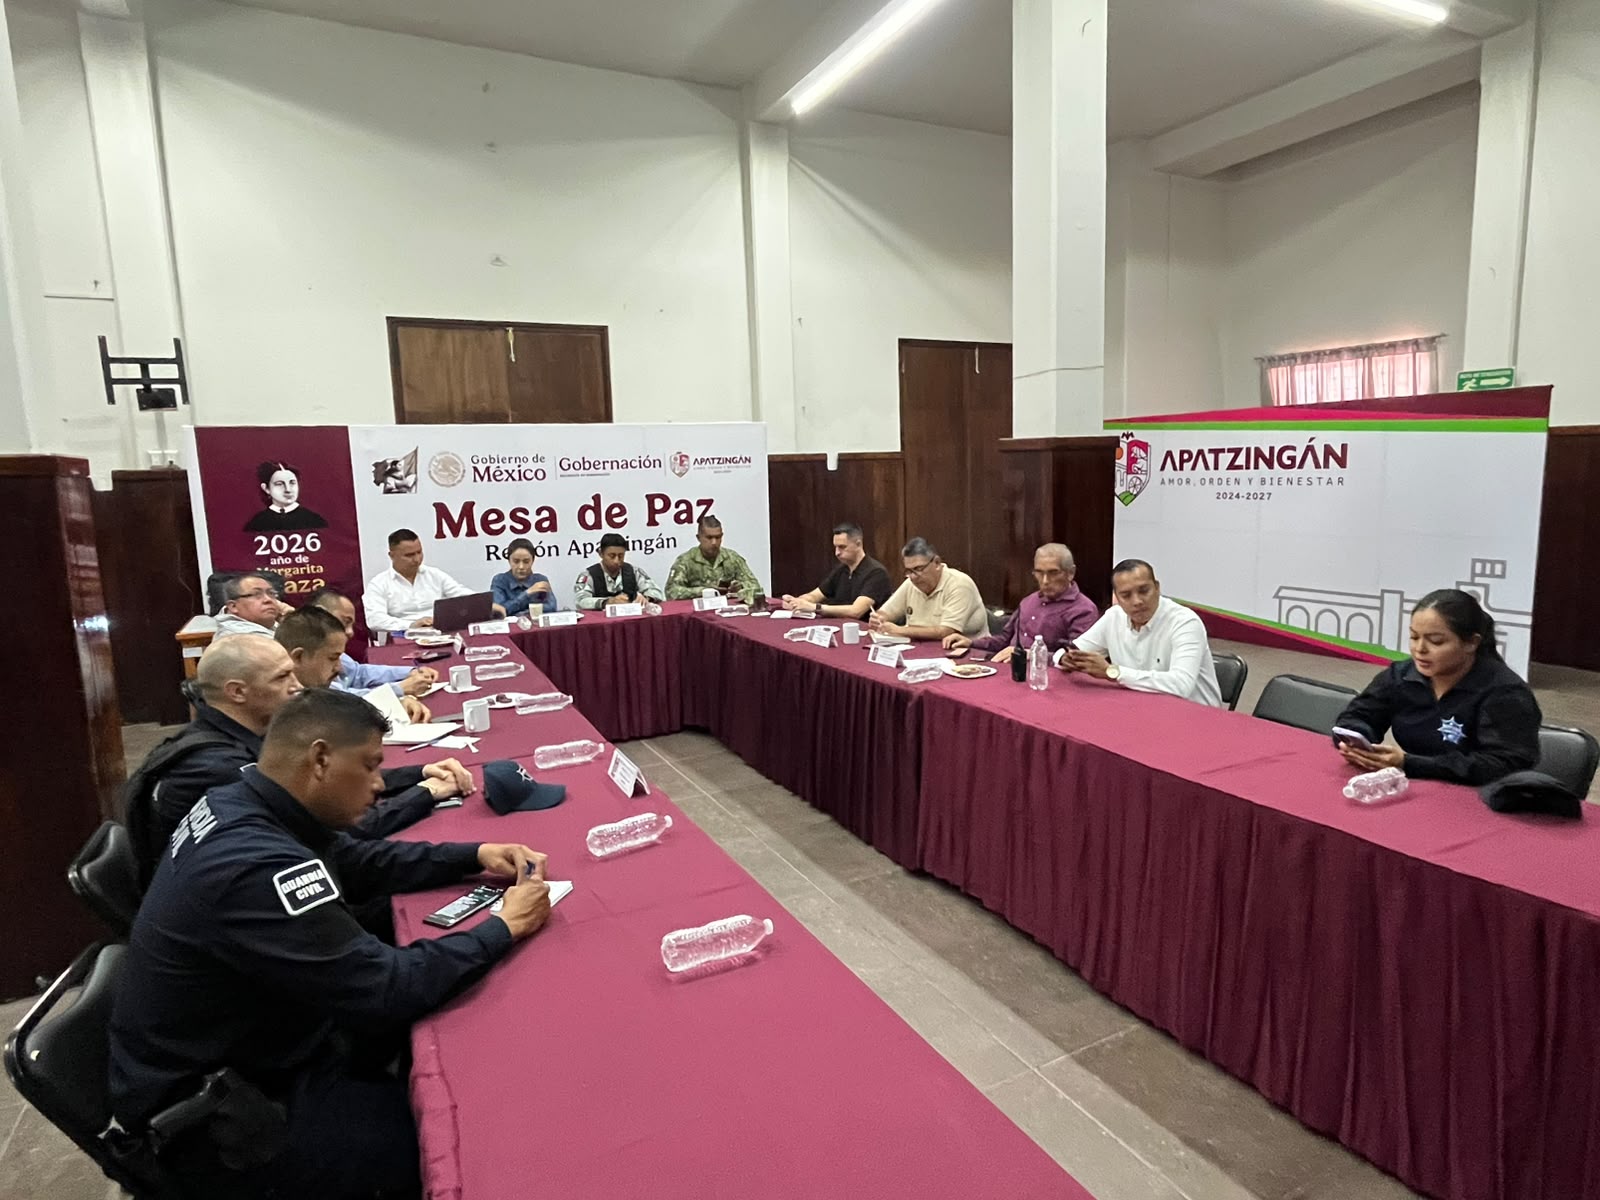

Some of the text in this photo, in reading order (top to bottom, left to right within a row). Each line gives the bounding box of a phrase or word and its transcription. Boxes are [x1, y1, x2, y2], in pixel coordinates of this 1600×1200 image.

[471, 453, 545, 465] Gobierno de
[693, 455, 751, 465] APATZINGÁN
[1160, 437, 1348, 471] APATZINGÁN
[559, 455, 662, 471] Gobernación
[472, 464, 547, 483] México
[1200, 477, 1241, 486] ORDEN
[1248, 477, 1253, 485] Y
[1260, 476, 1345, 486] BIENESTAR
[1216, 491, 1273, 501] 2024-2027
[432, 492, 714, 540] Mesa de Paz
[254, 533, 321, 555] 2026
[485, 533, 677, 561] Reón Apingán
[270, 554, 309, 565] año de
[284, 578, 325, 594] aza
[295, 882, 325, 900] CIVIL
